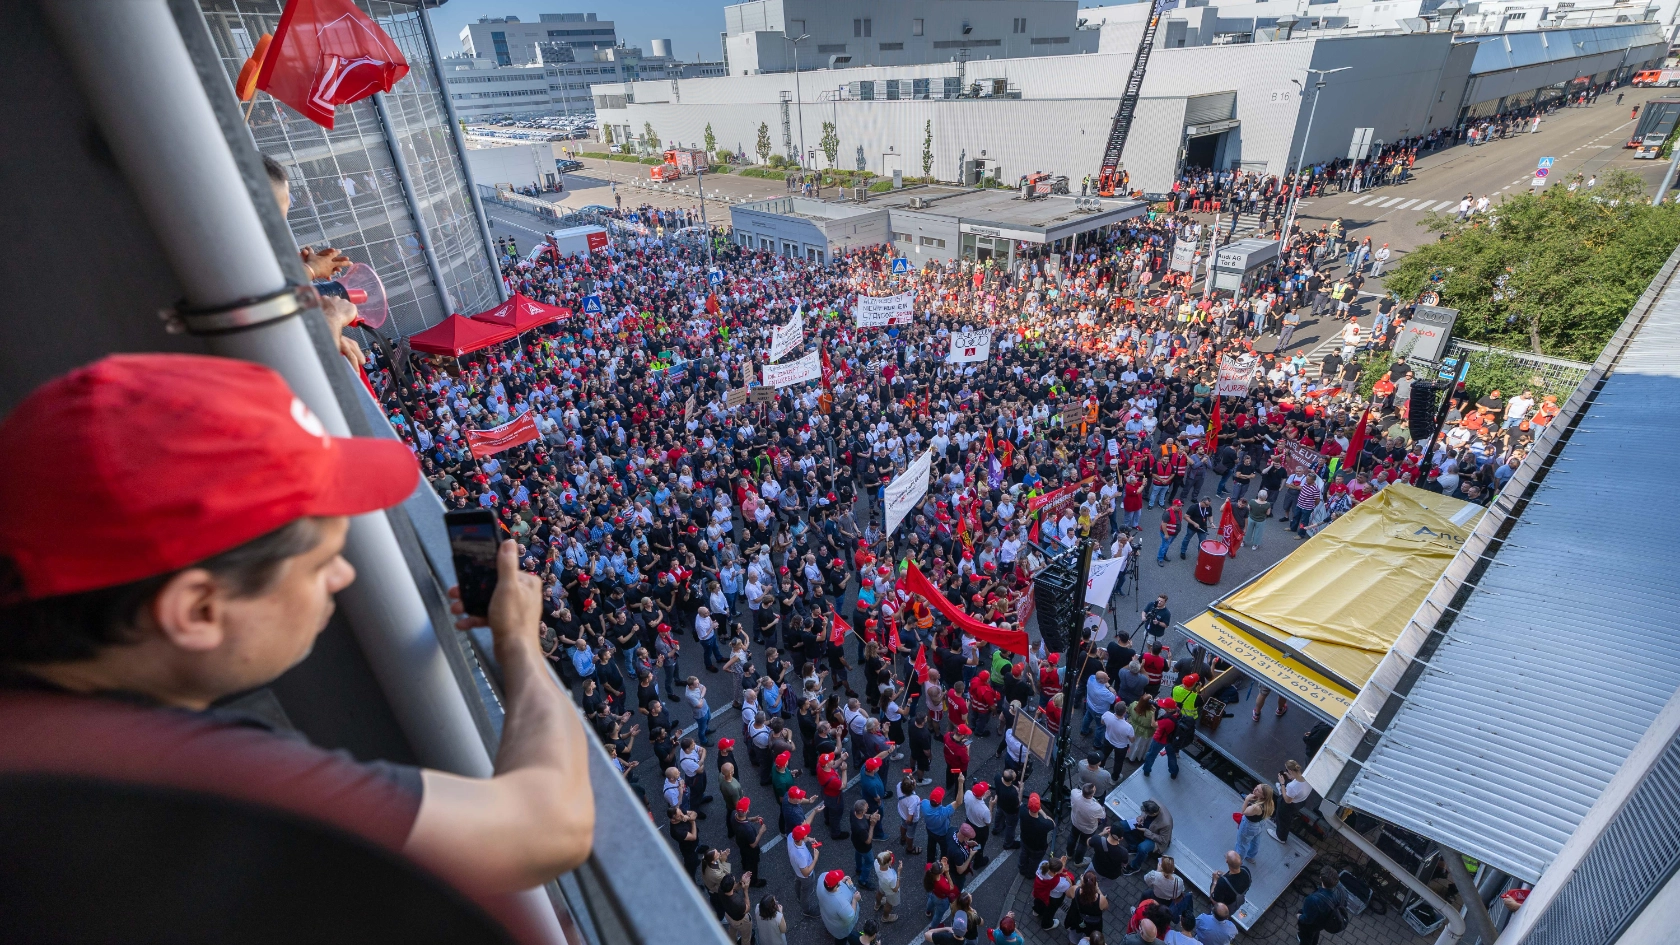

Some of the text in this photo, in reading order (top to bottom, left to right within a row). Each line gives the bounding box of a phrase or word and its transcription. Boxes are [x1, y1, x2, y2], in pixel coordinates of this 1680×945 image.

[1271, 91, 1290, 101] B 16
[1218, 253, 1231, 261] Audi
[1423, 295, 1435, 304] 30
[1410, 327, 1436, 337] Audi
[1217, 635, 1233, 649] Tel.
[1211, 623, 1351, 707] www.autoverleih-mayer.de
